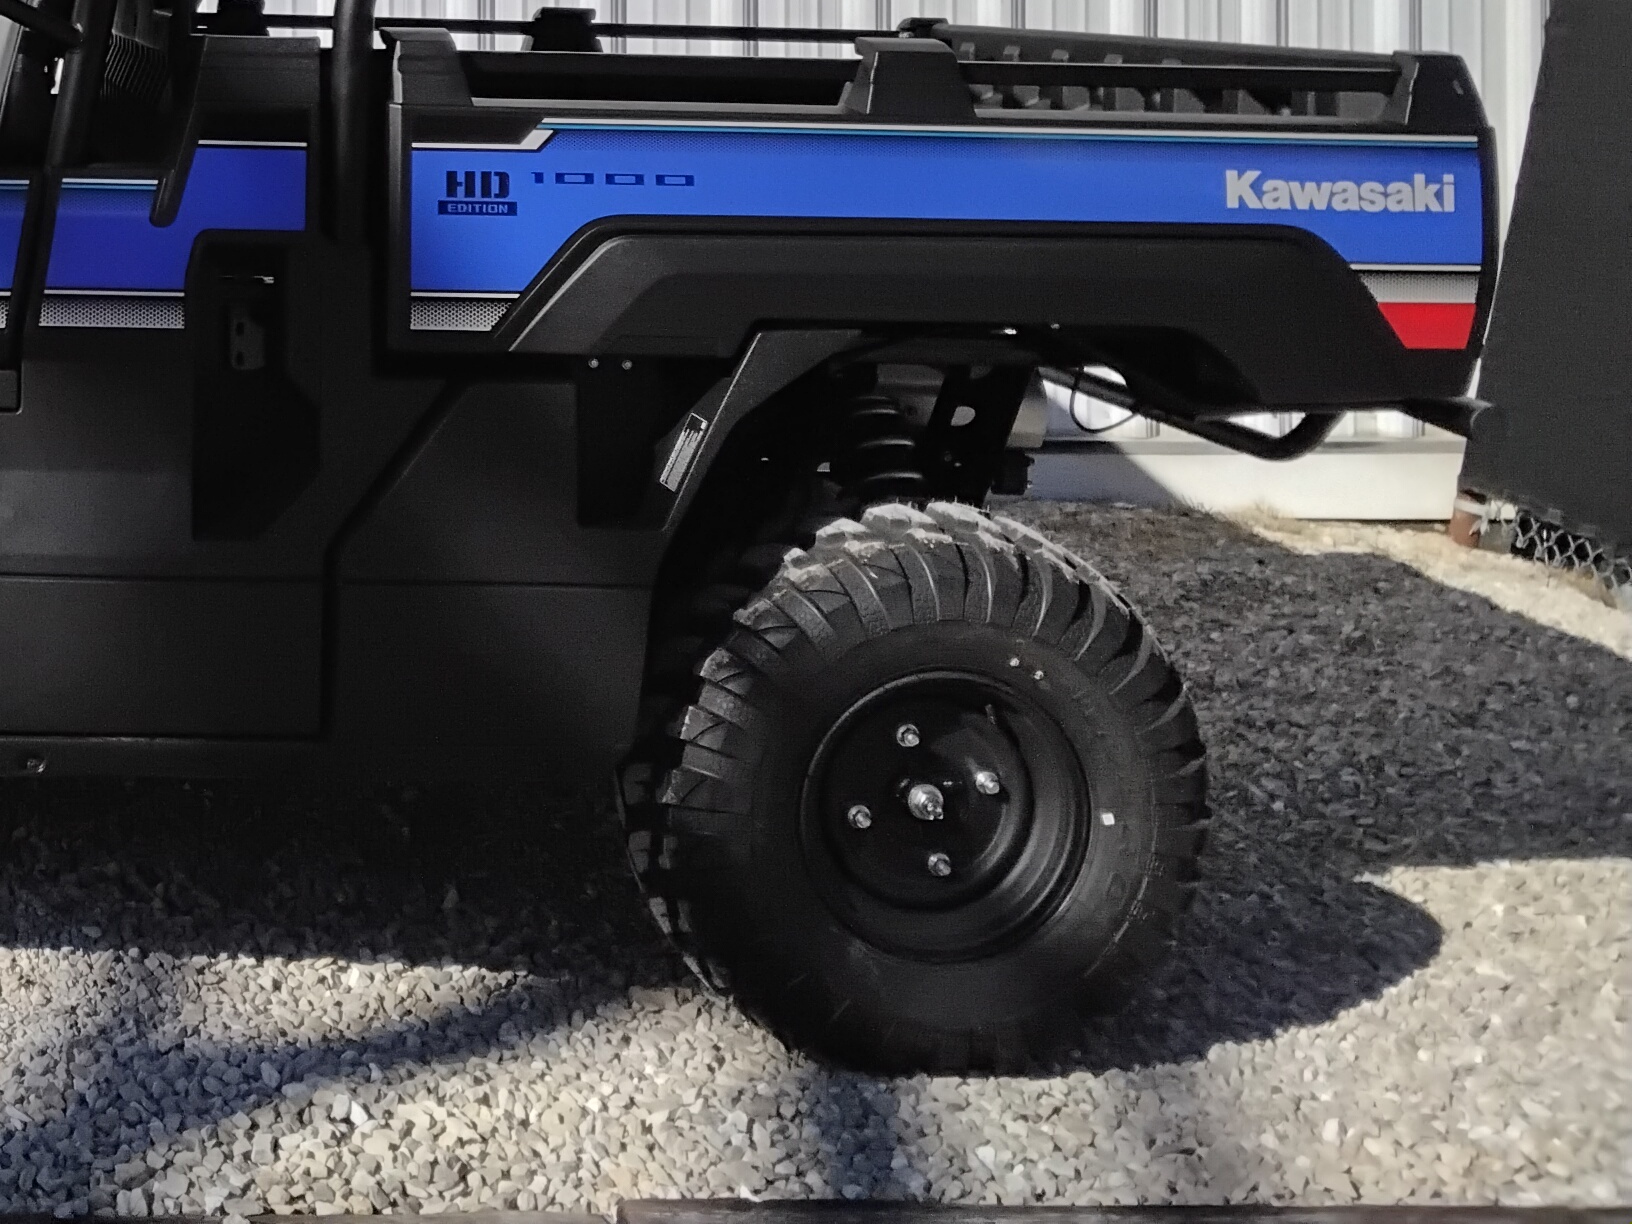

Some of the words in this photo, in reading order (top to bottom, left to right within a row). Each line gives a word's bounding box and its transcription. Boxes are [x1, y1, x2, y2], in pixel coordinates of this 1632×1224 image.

[446, 171, 510, 198] HD
[531, 171, 695, 187] 1000
[1225, 170, 1455, 212] Kawasaki
[447, 203, 509, 214] EDITION
